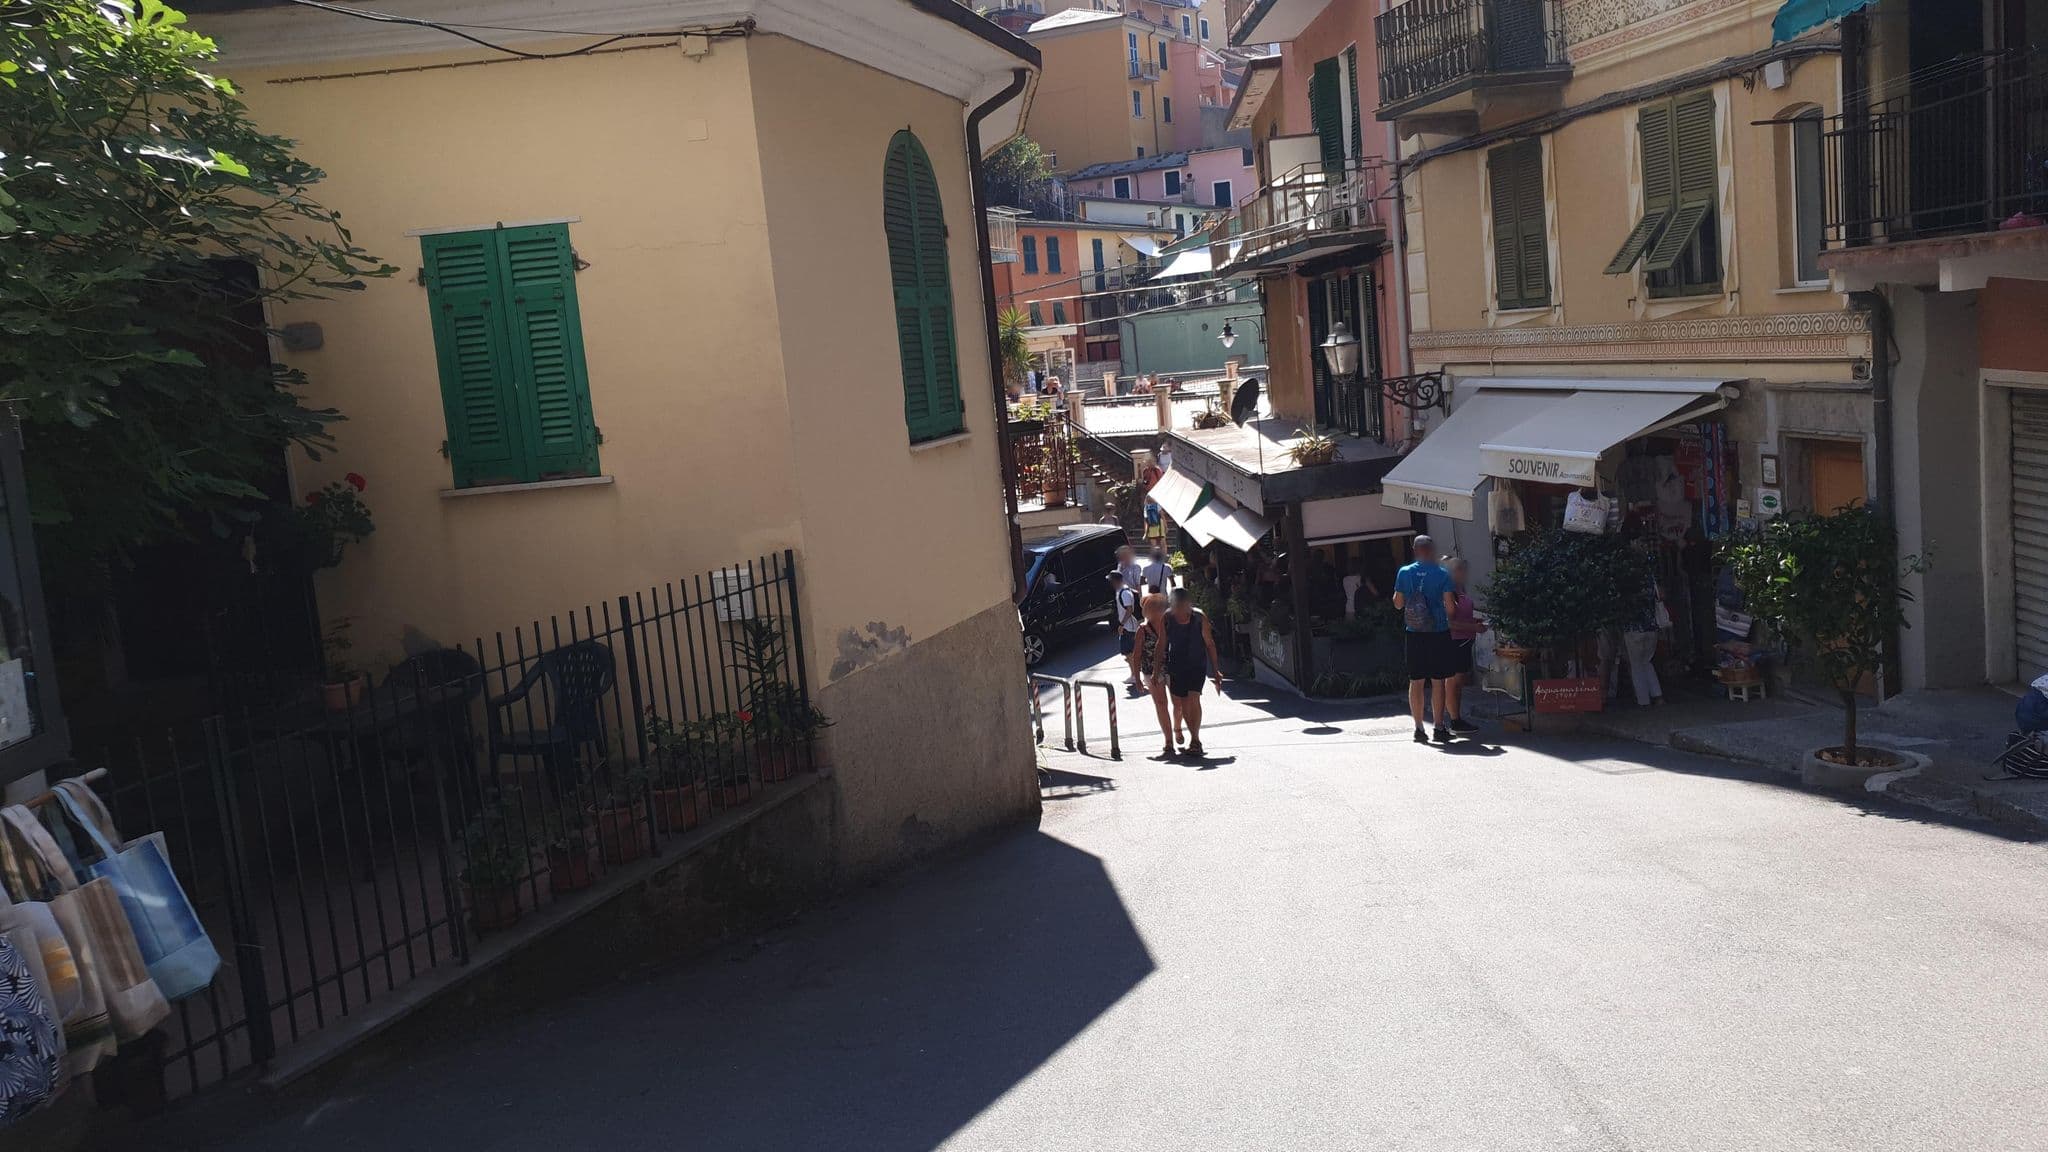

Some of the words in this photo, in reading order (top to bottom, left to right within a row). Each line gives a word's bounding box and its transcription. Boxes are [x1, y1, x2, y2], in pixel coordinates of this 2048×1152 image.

[1508, 459, 1560, 479] SOUVENIR
[1403, 492, 1419, 506] Mini
[1420, 495, 1449, 512] Market
